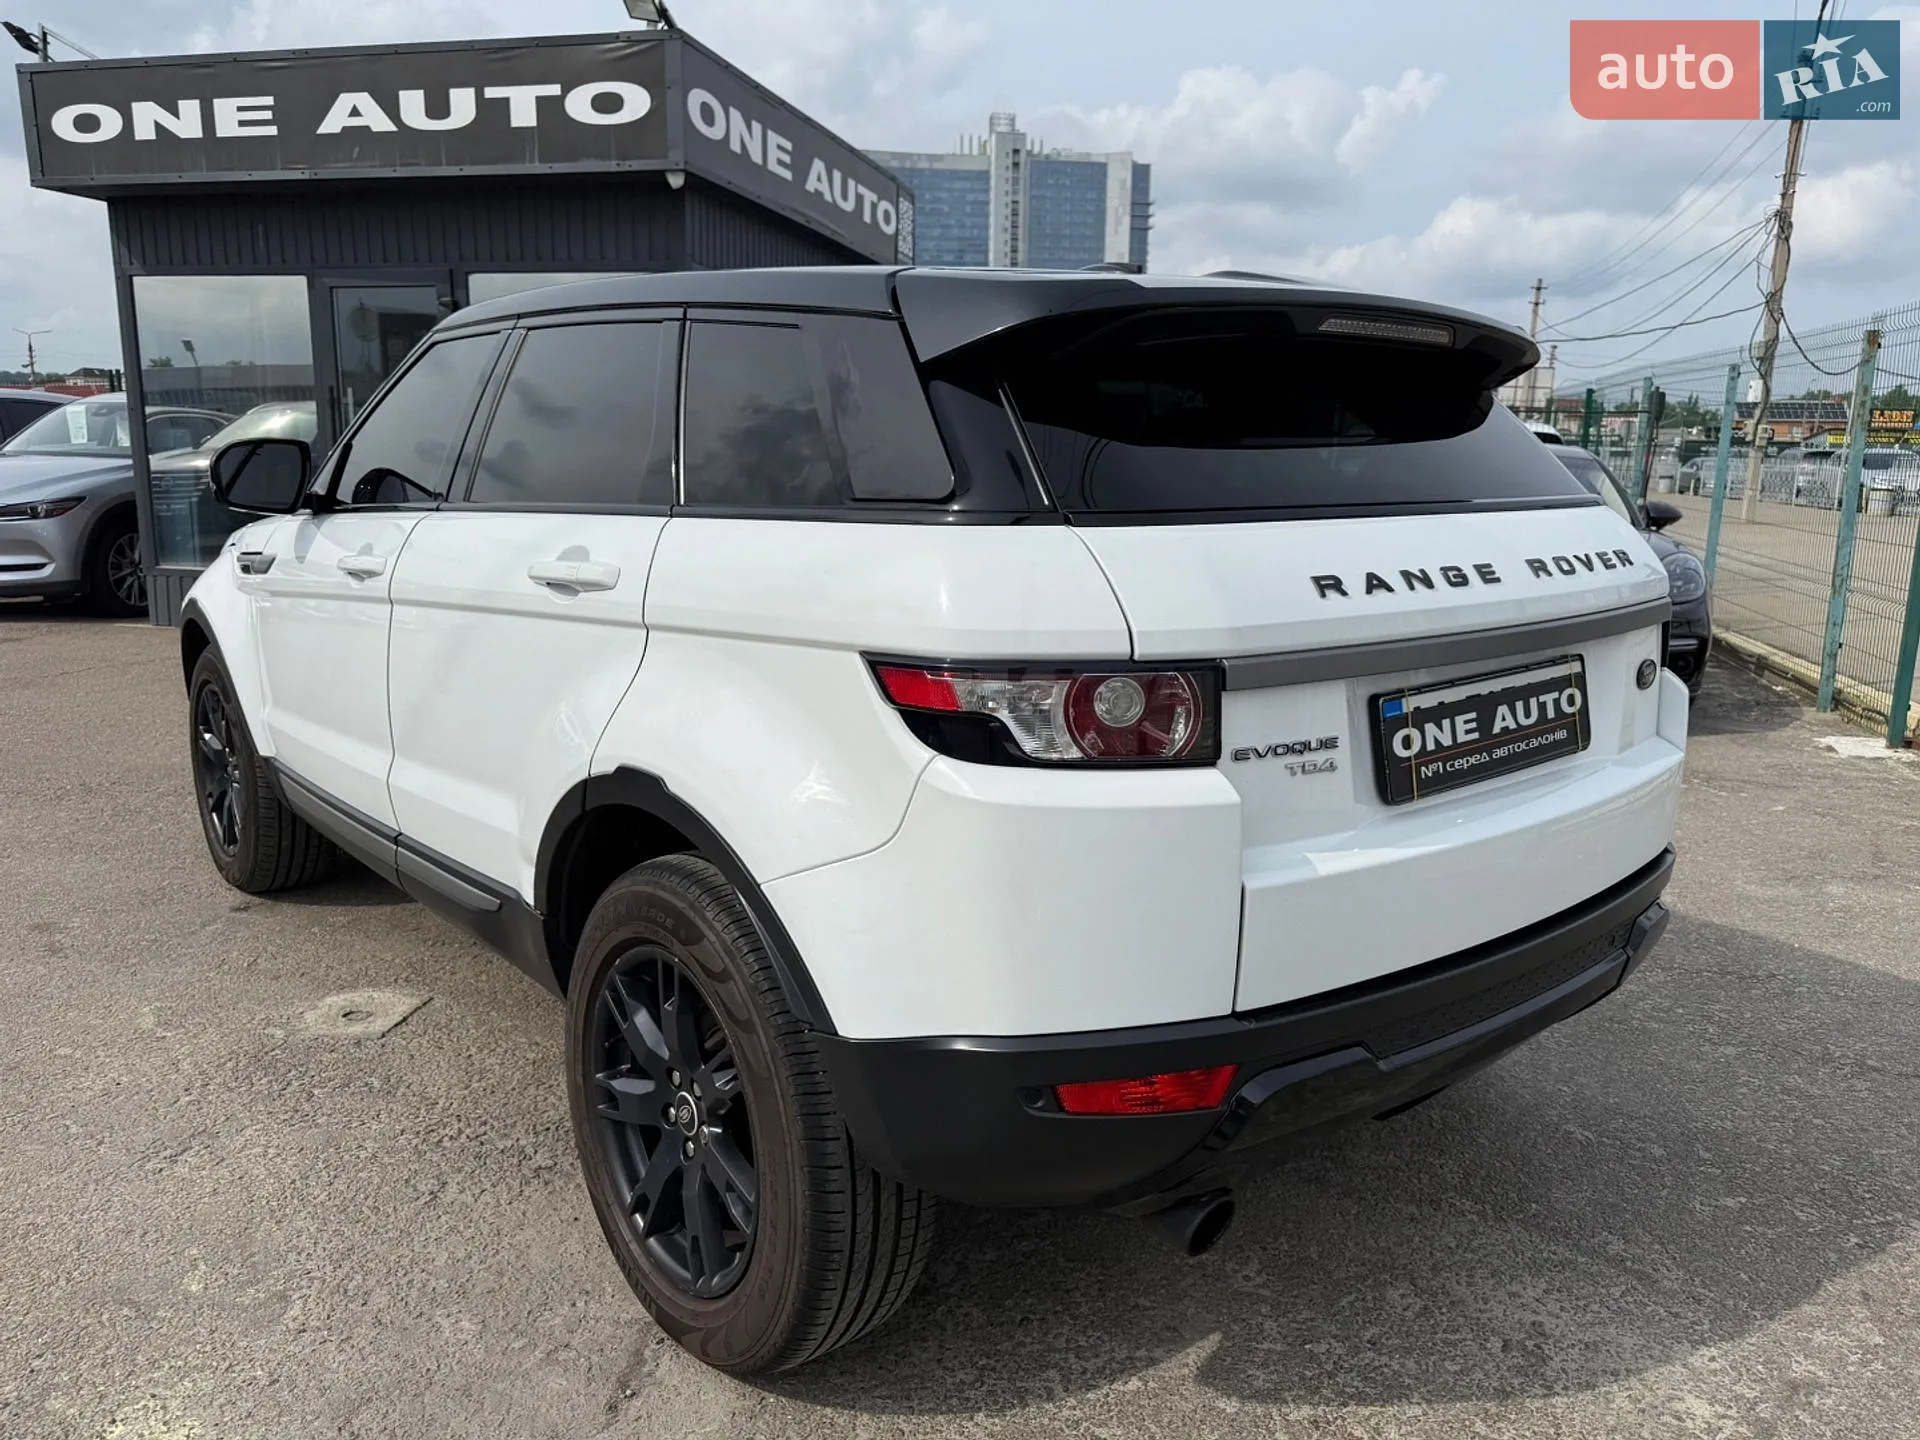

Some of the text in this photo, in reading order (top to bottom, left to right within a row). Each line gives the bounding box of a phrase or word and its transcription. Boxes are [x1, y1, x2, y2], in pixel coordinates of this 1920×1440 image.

[50, 81, 653, 144] ONE AUTO
[686, 87, 898, 237] ONE AUTO
[1309, 548, 1635, 599] RANGE ROVER
[1392, 687, 1583, 758] ONE AUTO
[1231, 736, 1340, 762] EVOQUE
[1284, 757, 1339, 778] TD4
[1446, 751, 1491, 772] серед
[1492, 727, 1569, 760] автосалонів
